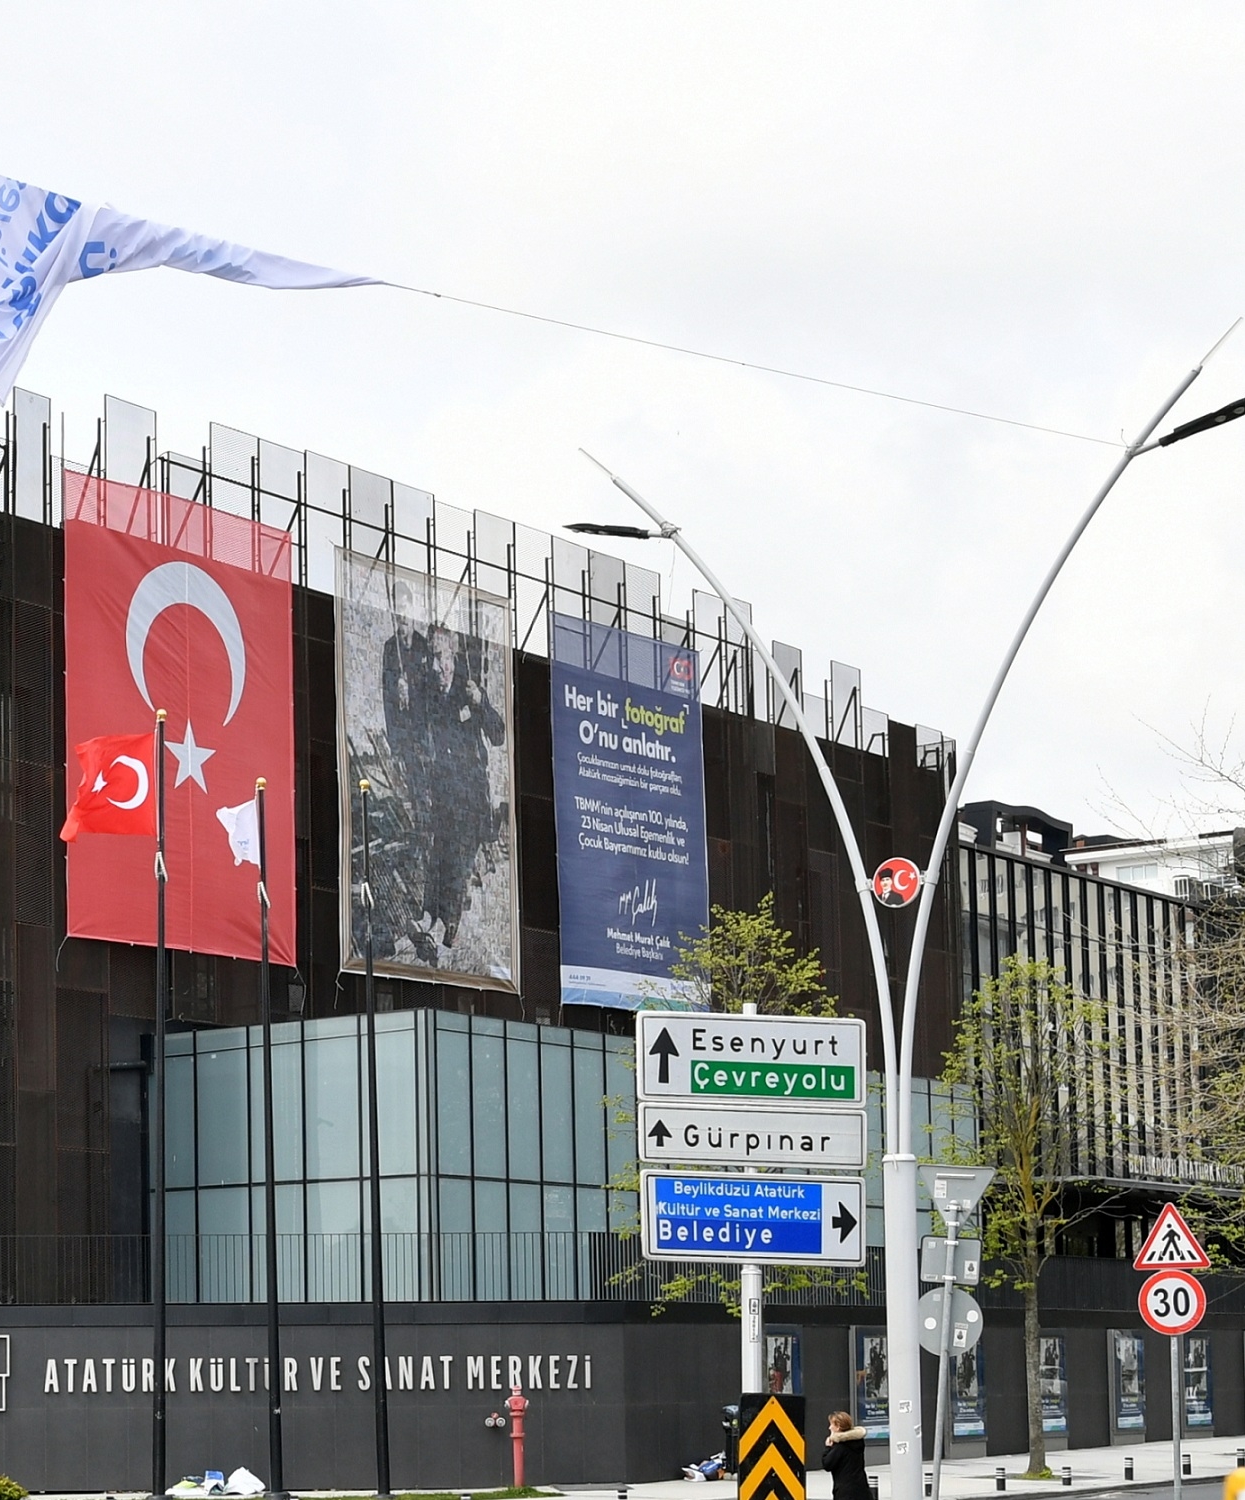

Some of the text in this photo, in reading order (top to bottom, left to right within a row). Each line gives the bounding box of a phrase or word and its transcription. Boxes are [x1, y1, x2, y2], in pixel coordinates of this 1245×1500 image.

[564, 684, 685, 735] Her bir fotoğraf
[579, 720, 676, 763] O'nu anlatır.
[579, 766, 601, 779] Atatürk
[640, 778, 648, 789] bir
[649, 782, 669, 794] parçası
[620, 763, 636, 773] umut
[637, 765, 649, 776] dolu
[574, 796, 688, 832] TBMM'nin açılışının 100. yılında,
[581, 815, 685, 847] 23 Nisan Ulusal Egemenlik ve
[579, 832, 689, 865] Çocuk Bayramımız kutlu olsun!
[607, 927, 671, 950] Mehmet Murat Çalık
[616, 942, 663, 962] Belediye Başkanı
[692, 1028, 838, 1060] Esenyurt
[693, 1062, 846, 1096] Çevreyolu
[683, 1124, 831, 1156] Gürpınar
[674, 1181, 805, 1199] Beylikdüzü Atatürk
[658, 1202, 821, 1220] Kültür ve Sanat Merkezi
[659, 1219, 773, 1249] Belediye
[1153, 1287, 1190, 1317] 30
[44, 1358, 176, 1393] ATATÜRK
[310, 1357, 342, 1392] VE
[467, 1354, 591, 1390] MERKEZİ
